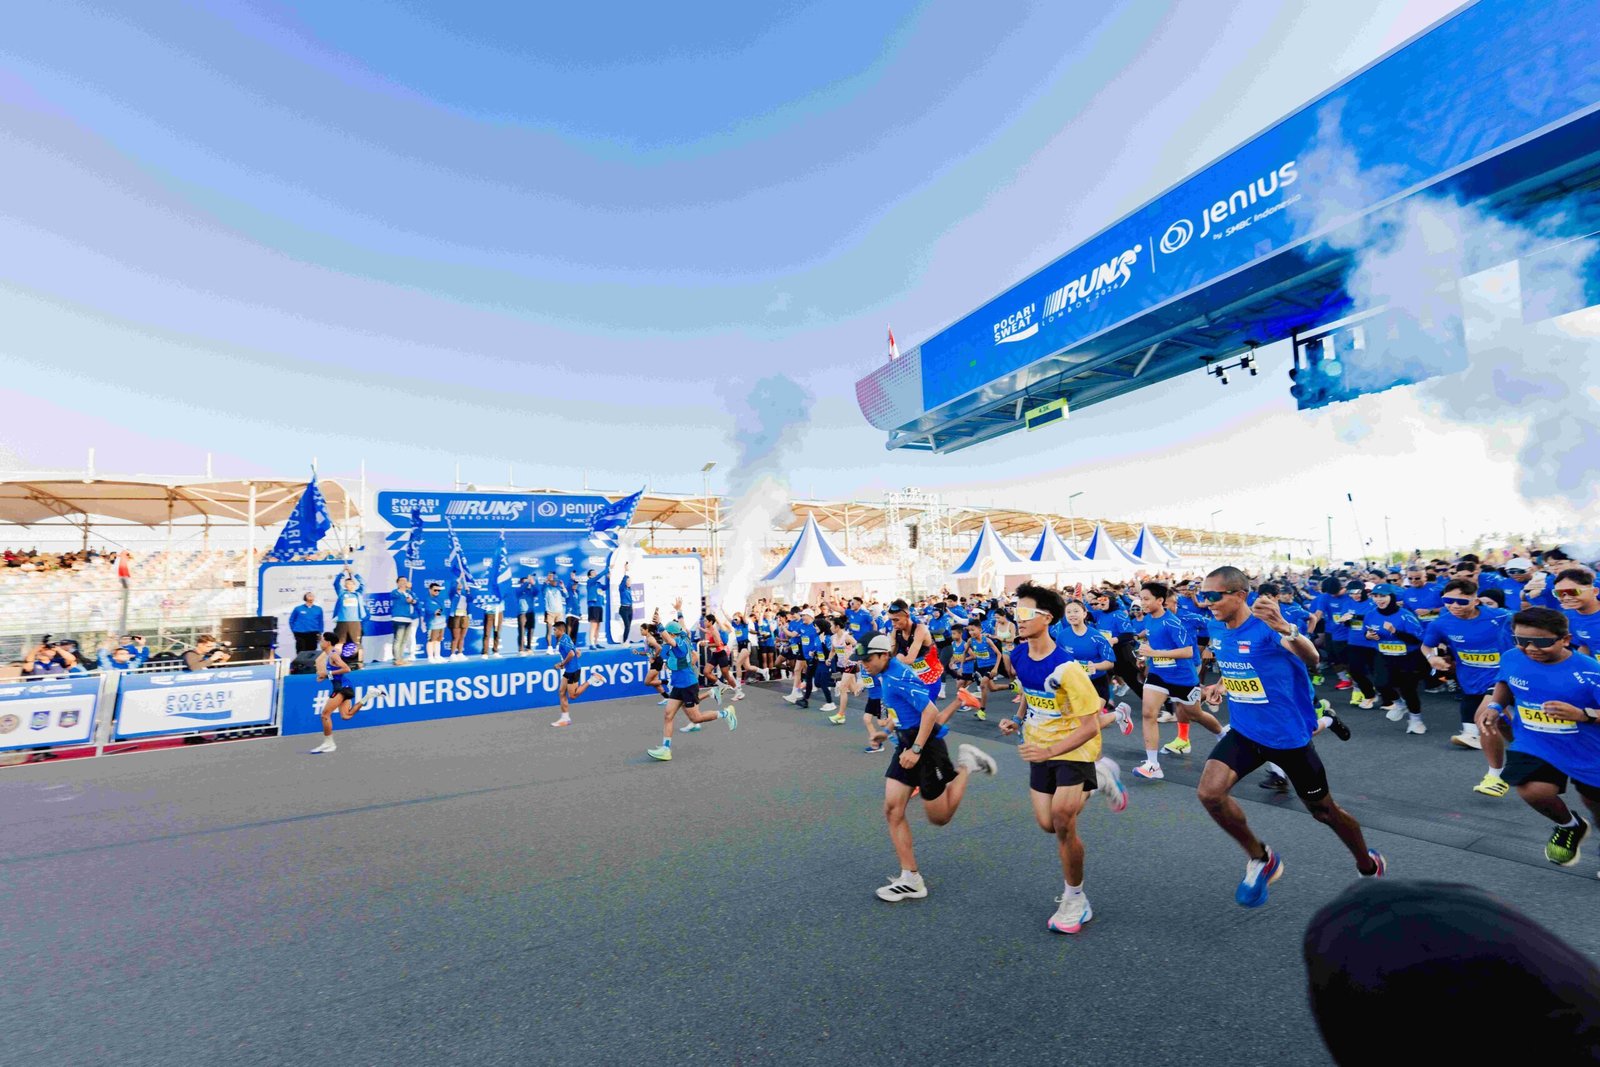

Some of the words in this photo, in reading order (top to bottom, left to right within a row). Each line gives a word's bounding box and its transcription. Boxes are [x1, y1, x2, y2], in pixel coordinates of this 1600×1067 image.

[1225, 216, 1252, 237] SMBC
[1042, 297, 1092, 327] LOMBOK
[1095, 284, 1119, 299] 2026
[994, 302, 1036, 334] POCARI
[994, 314, 1032, 342] SWEAT
[391, 498, 440, 507] POCARI
[1462, 653, 1496, 662] 51770
[166, 690, 233, 704] POCARI
[165, 700, 225, 713] SWEAT
